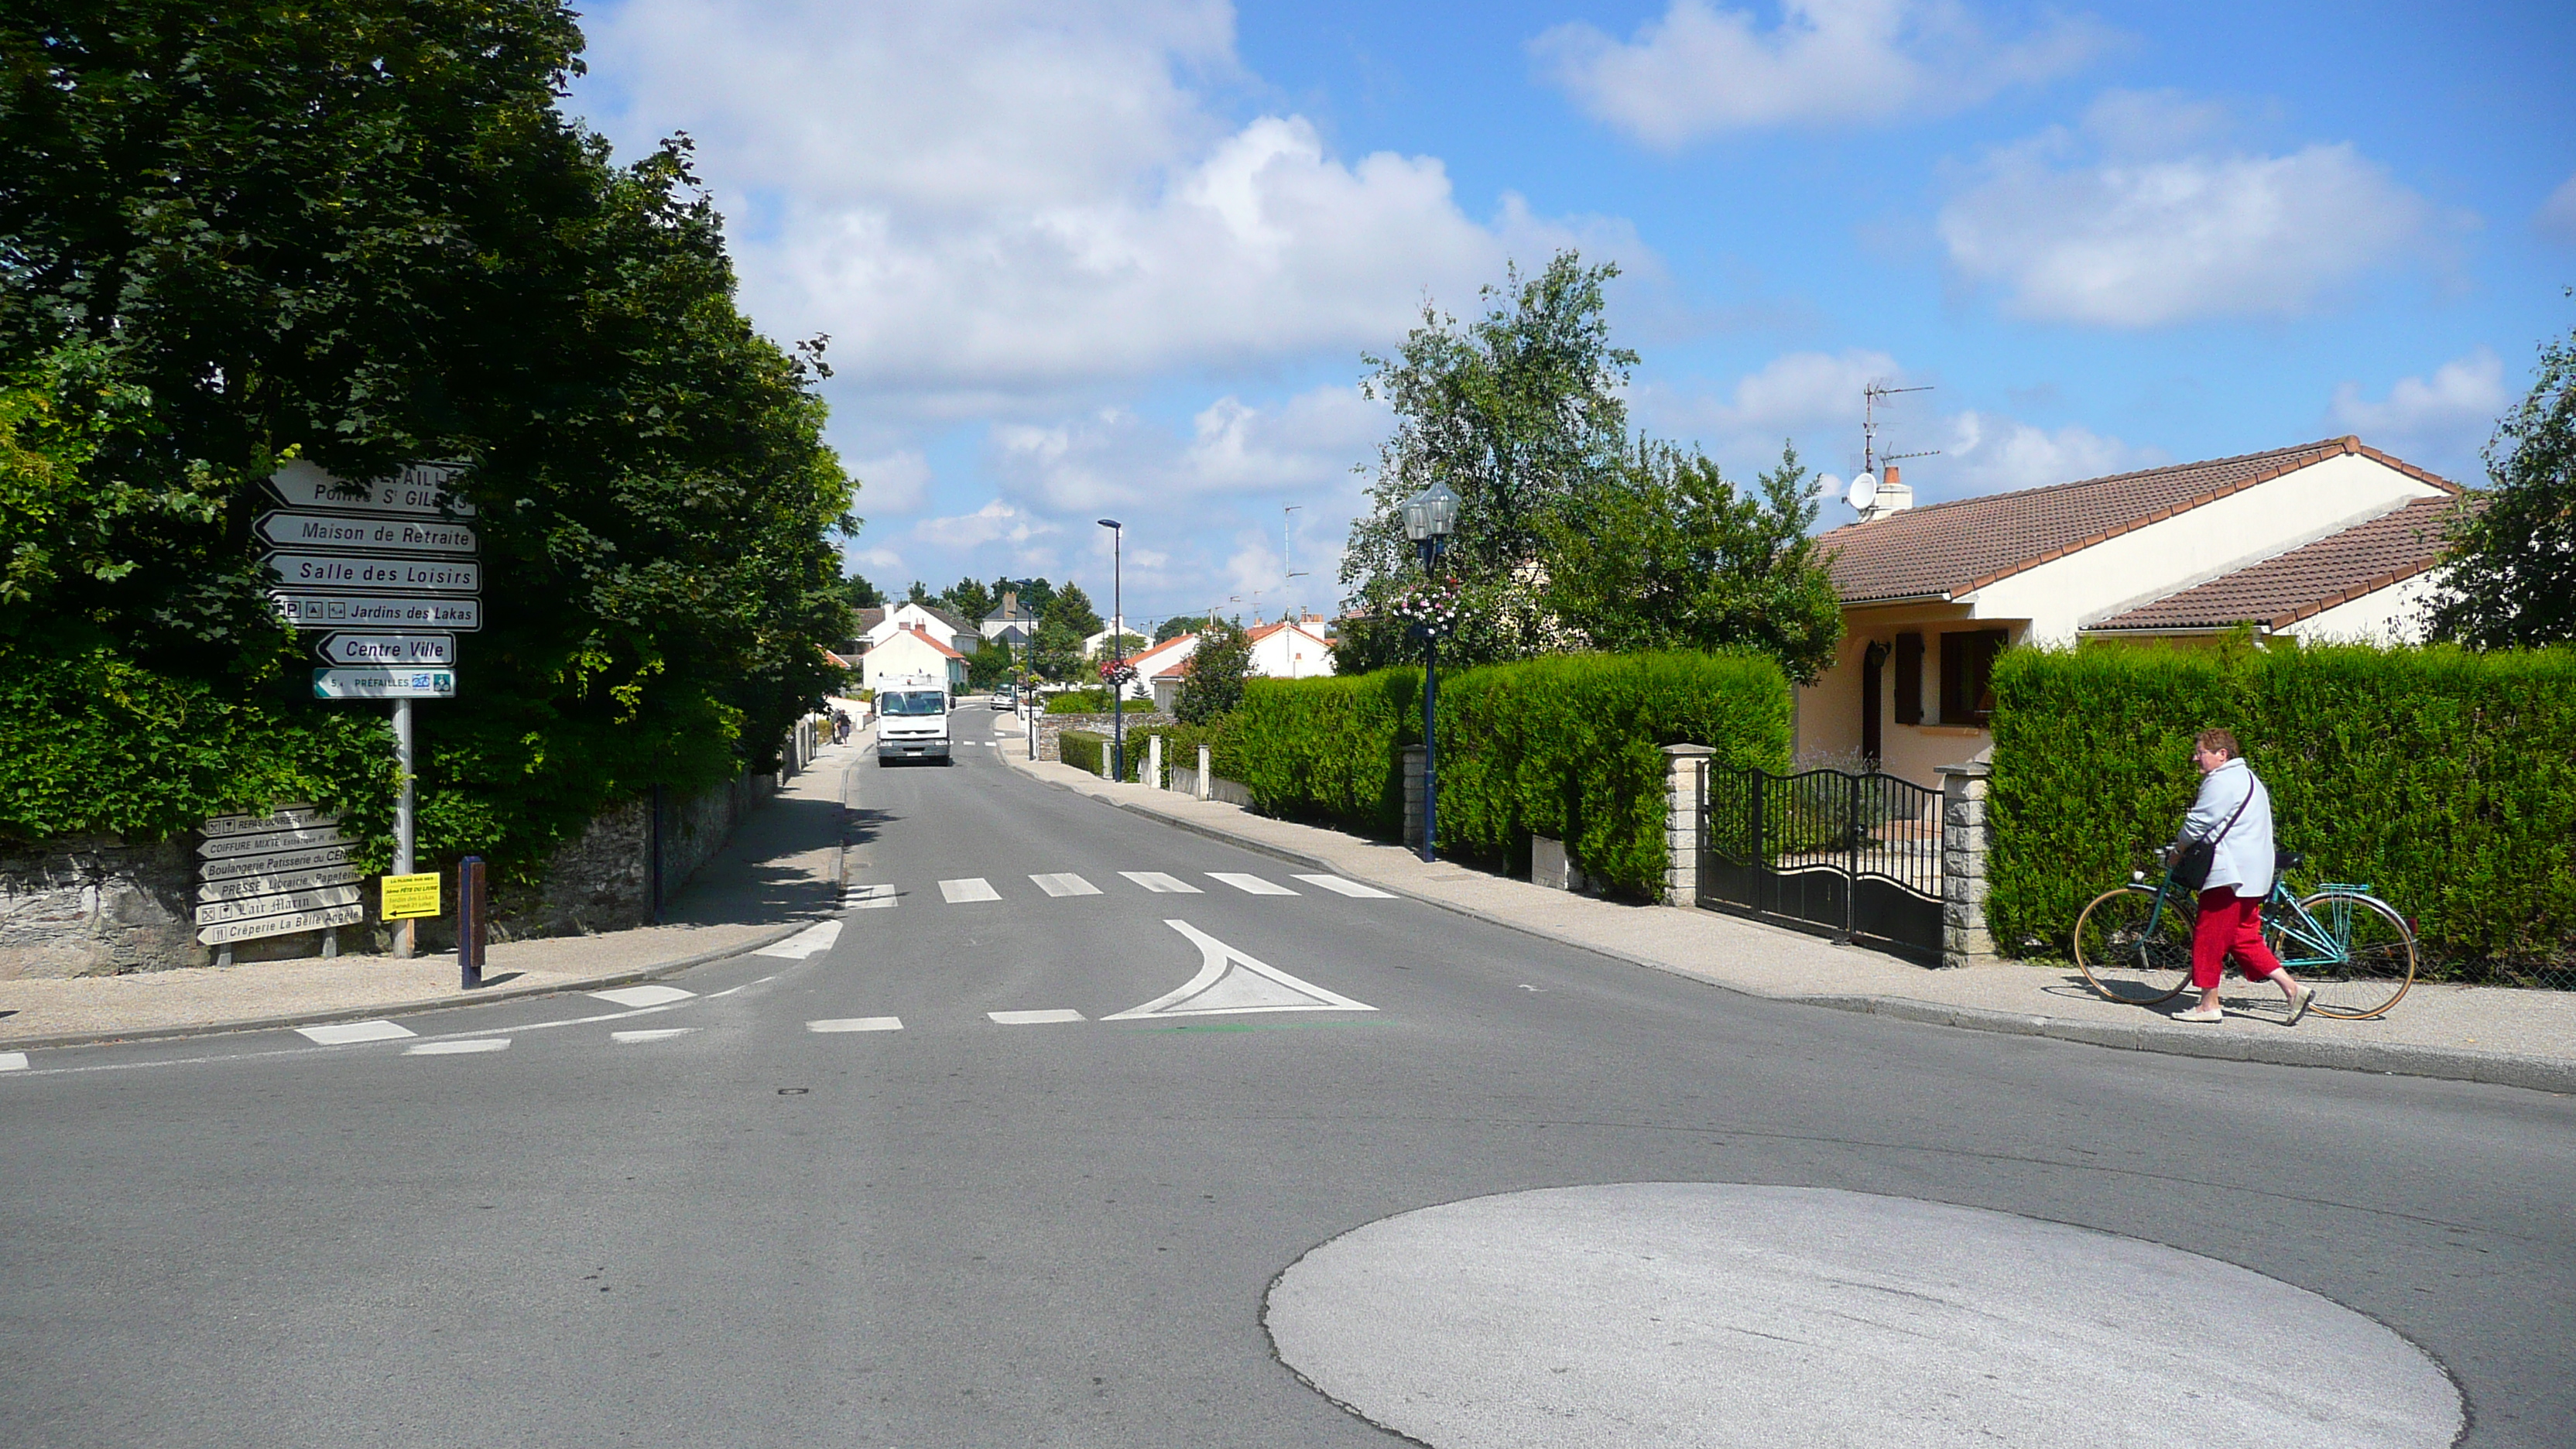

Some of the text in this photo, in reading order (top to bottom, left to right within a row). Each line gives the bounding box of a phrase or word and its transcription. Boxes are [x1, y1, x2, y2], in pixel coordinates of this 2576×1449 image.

[302, 522, 469, 545] Maison de Retraite
[300, 563, 471, 584] Salle des Loisirs
[351, 605, 401, 618] Jardins
[407, 607, 430, 619] des
[434, 607, 472, 620] Lakas
[346, 642, 444, 657] Centre Ville
[355, 677, 409, 687] PRÉFAILLES
[238, 819, 262, 829] REPAS
[265, 815, 302, 827] OUVRIERS
[210, 841, 251, 853] COIFFURE
[255, 838, 280, 848] MIXTE
[208, 861, 265, 875] Boulangerie
[267, 855, 311, 868] Patisserie
[313, 854, 324, 863] du
[221, 869, 360, 896] PRESSE Librairie Papeterie
[270, 898, 310, 913] Marin
[230, 909, 359, 937] Crêperie La Belle Angèle
